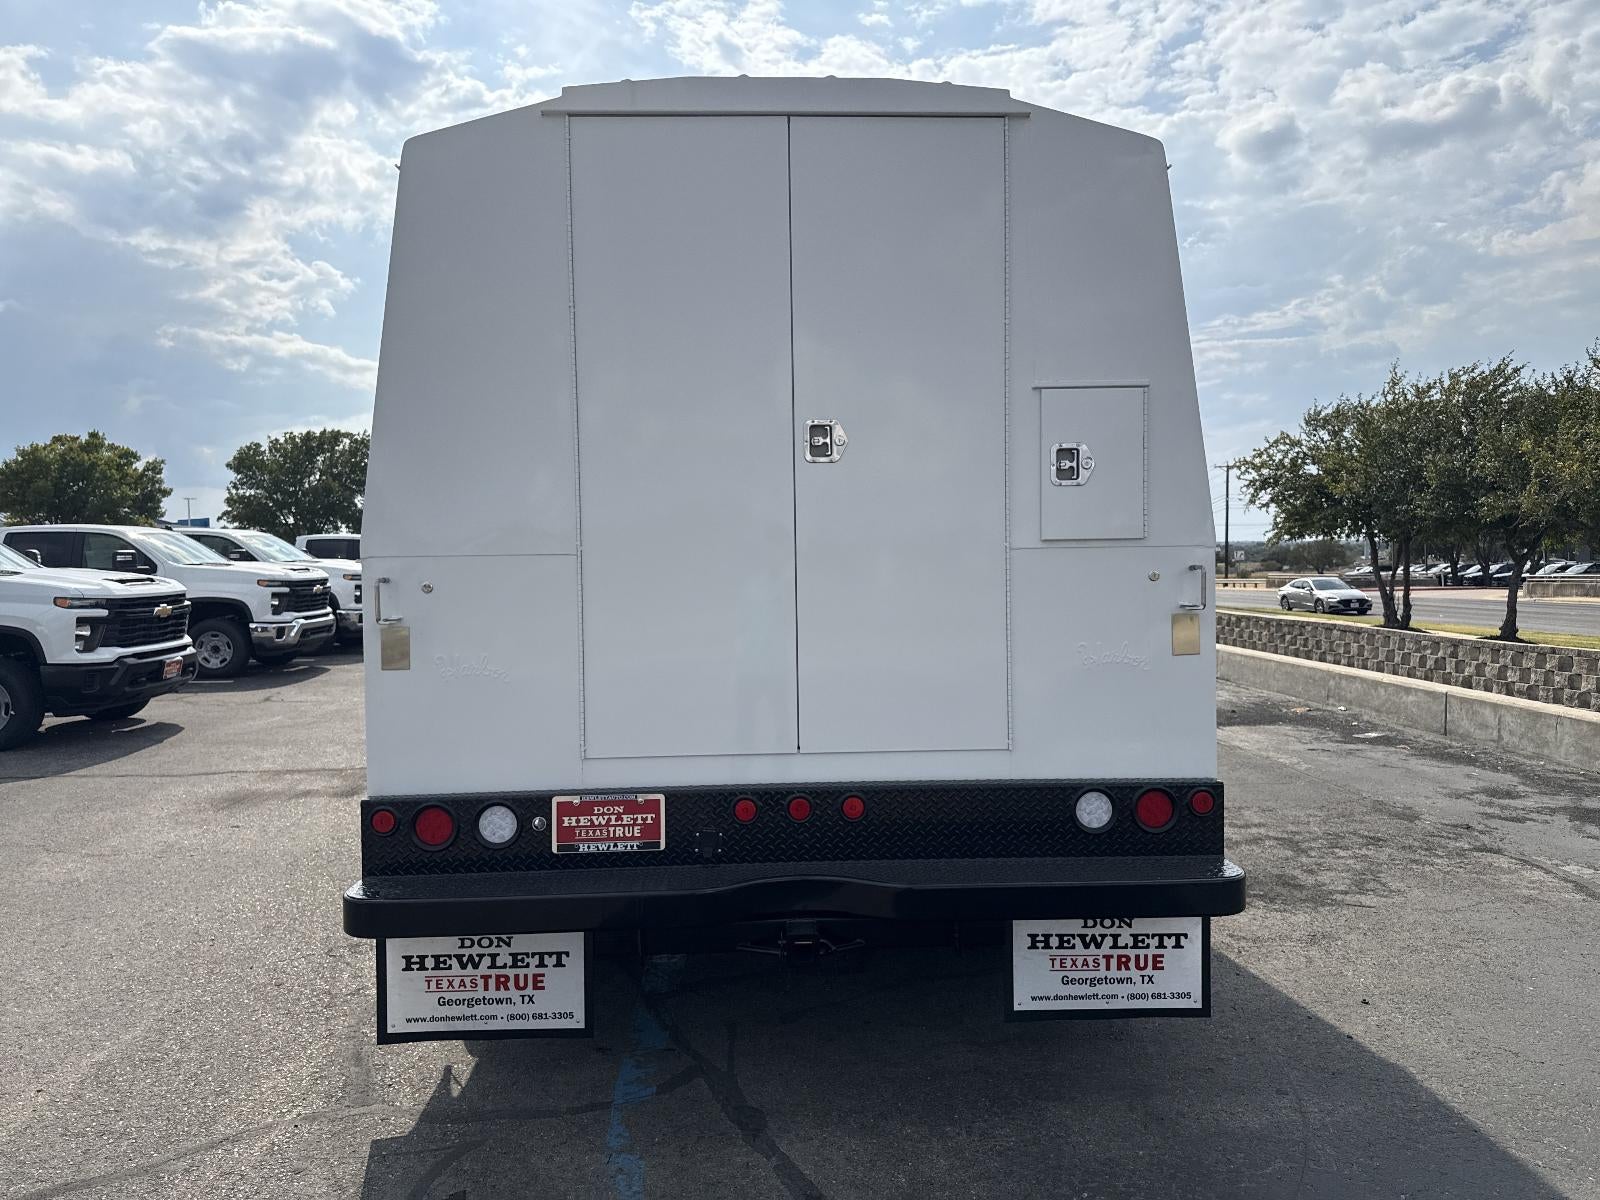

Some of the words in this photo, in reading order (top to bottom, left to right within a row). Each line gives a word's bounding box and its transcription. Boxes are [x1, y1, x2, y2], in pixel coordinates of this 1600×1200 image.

[593, 806, 625, 814] DON
[562, 814, 656, 827] HEWLETT
[578, 842, 641, 852] HEWLETT
[1081, 918, 1135, 929] DON
[457, 936, 514, 949] DON
[1026, 933, 1189, 950] HEWLETT
[401, 951, 570, 972] HEWLETT
[1061, 975, 1137, 988] Georgetown,
[1139, 975, 1155, 985] TX
[437, 995, 517, 1009] Georgetown,
[519, 994, 536, 1005] TX
[1030, 992, 1119, 1002] www.donhewlett.com
[1126, 992, 1150, 1002] (800)
[1150, 991, 1193, 1001] 681-3305
[405, 1012, 499, 1024] www.donhewlett.com
[506, 1012, 531, 1022] (800)
[531, 1011, 575, 1021] 681-3305
